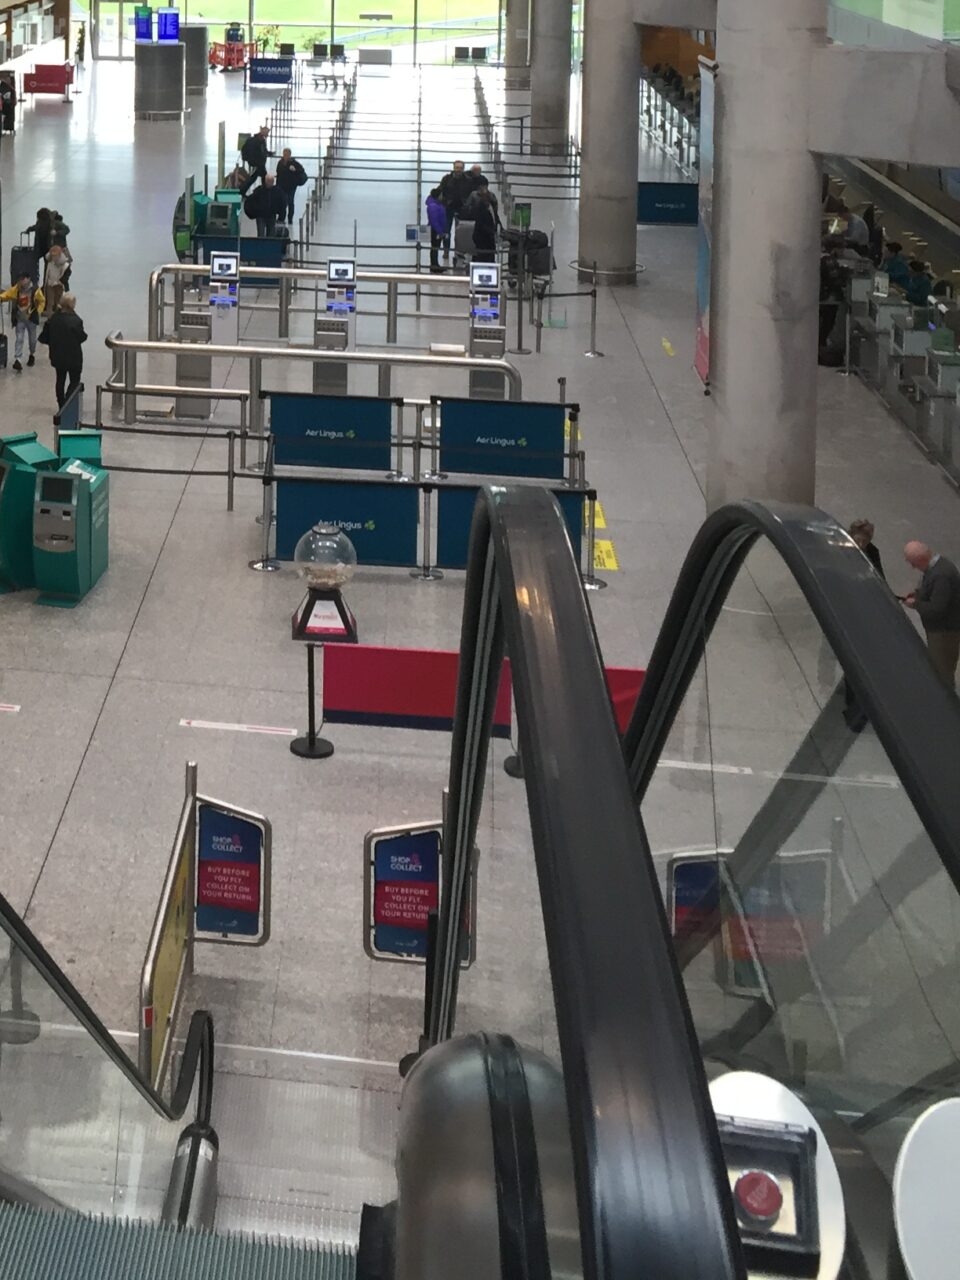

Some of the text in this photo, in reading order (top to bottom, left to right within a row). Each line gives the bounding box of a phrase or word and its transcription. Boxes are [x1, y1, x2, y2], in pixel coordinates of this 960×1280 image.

[305, 429, 344, 439] Aer Lingus
[476, 436, 516, 447] Aer Lingus
[333, 519, 362, 529] Lingus
[212, 835, 231, 843] SHOP
[211, 843, 243, 853] COLLECT
[390, 863, 422, 872] COLLECT
[222, 868, 250, 877] BEFORE
[206, 882, 250, 893] COLLECT ON
[400, 887, 429, 896] BEFORE
[202, 889, 222, 897] YOUR
[384, 902, 416, 911] COLLECT
